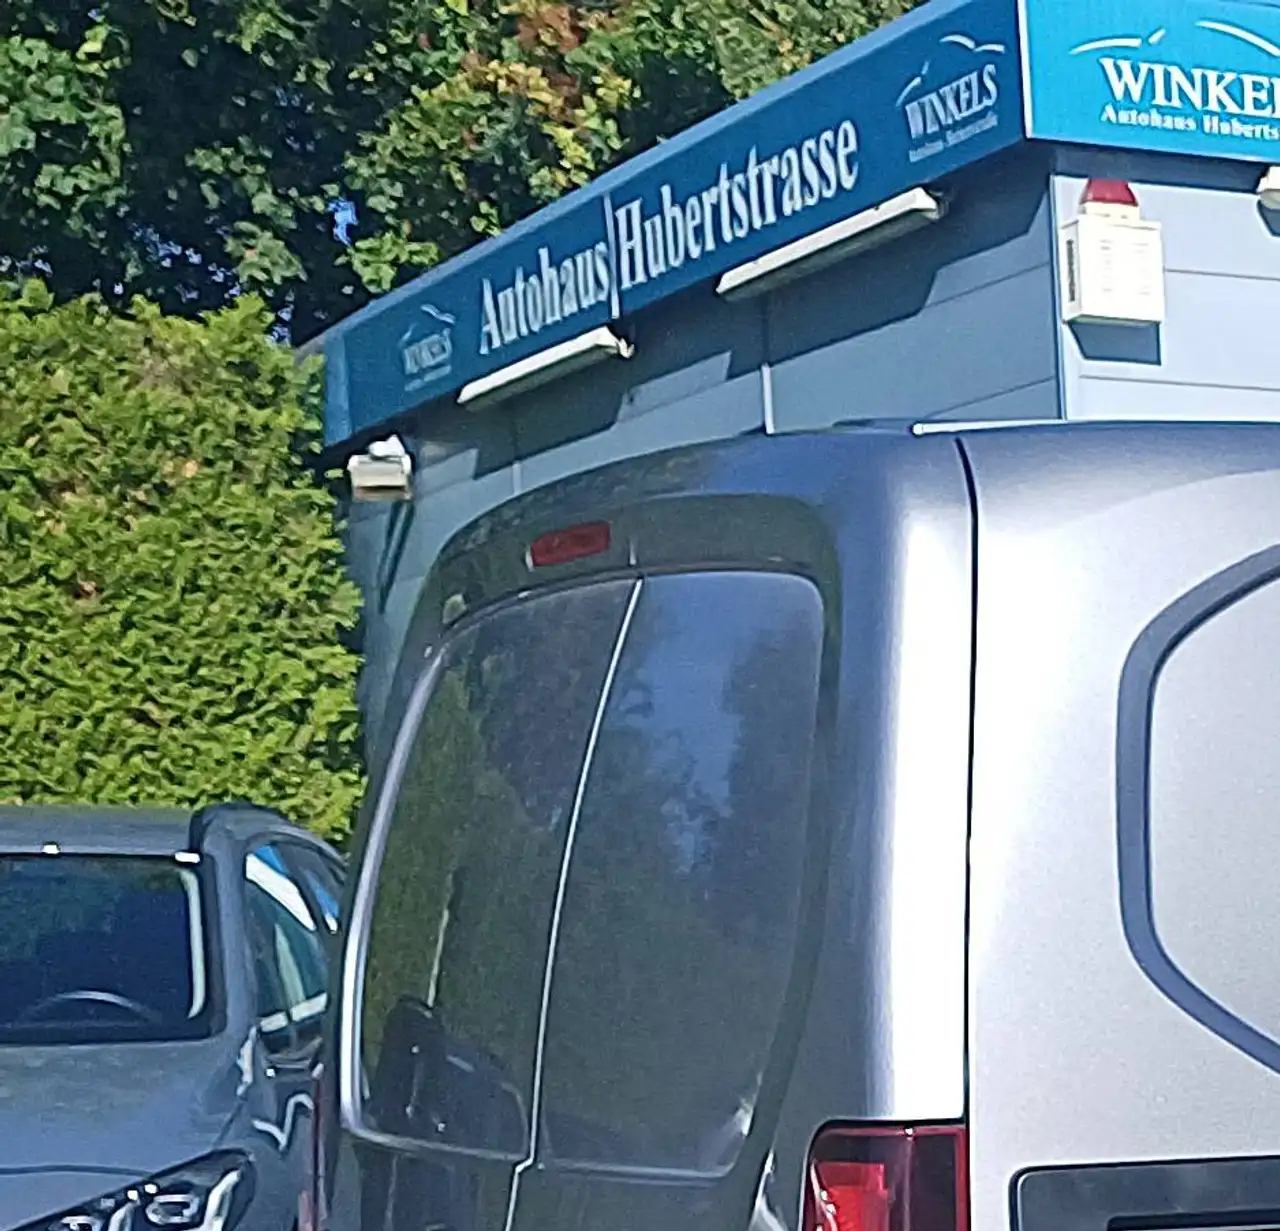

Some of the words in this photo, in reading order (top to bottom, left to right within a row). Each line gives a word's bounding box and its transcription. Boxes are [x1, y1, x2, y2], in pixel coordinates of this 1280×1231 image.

[1101, 103, 1197, 132] Autohaus
[479, 241, 610, 355] Autohaus
[615, 120, 859, 290] Hubertstrasse
